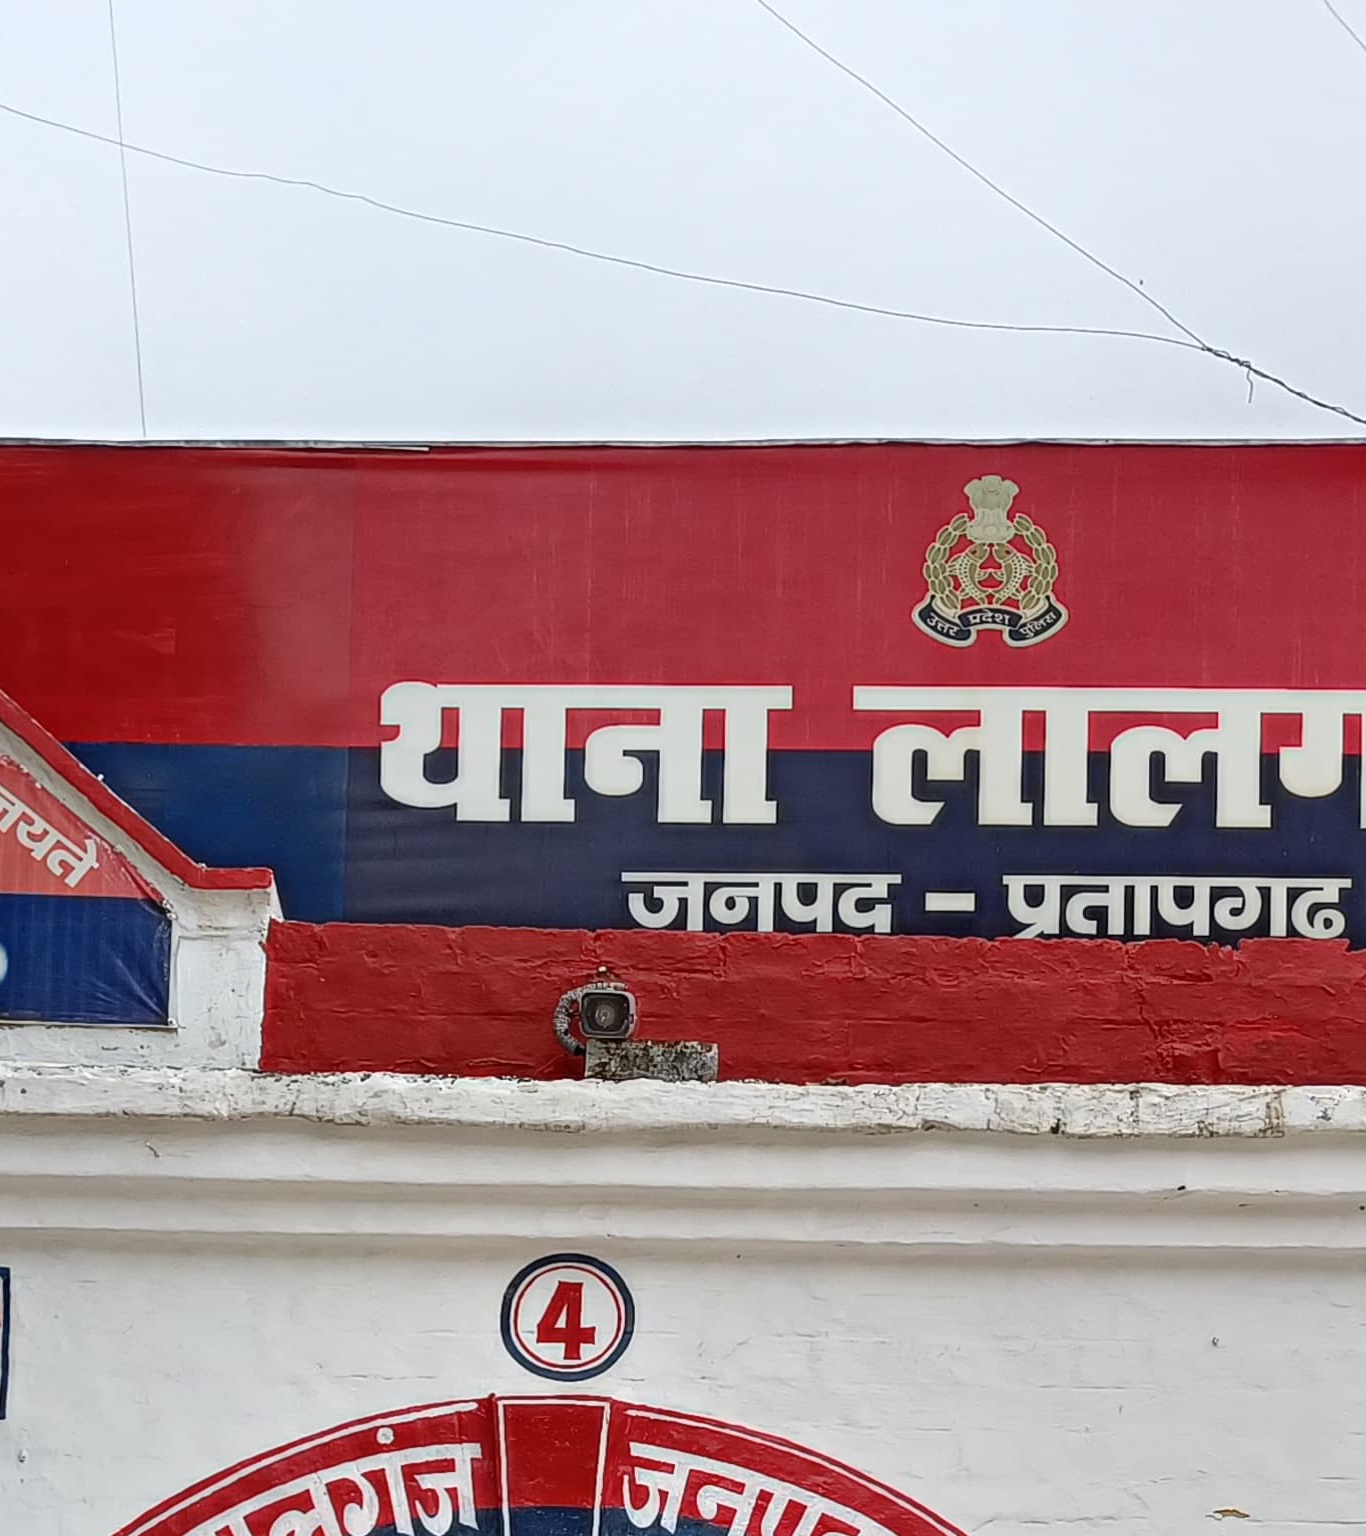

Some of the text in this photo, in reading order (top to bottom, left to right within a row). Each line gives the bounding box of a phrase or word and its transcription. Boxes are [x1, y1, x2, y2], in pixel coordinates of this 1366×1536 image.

[926, 608, 1058, 640] उत्तर प्रदेश पुलिस
[379, 680, 793, 825] थाना
[621, 871, 902, 934] जनपद
[535, 1280, 597, 1361] 4
